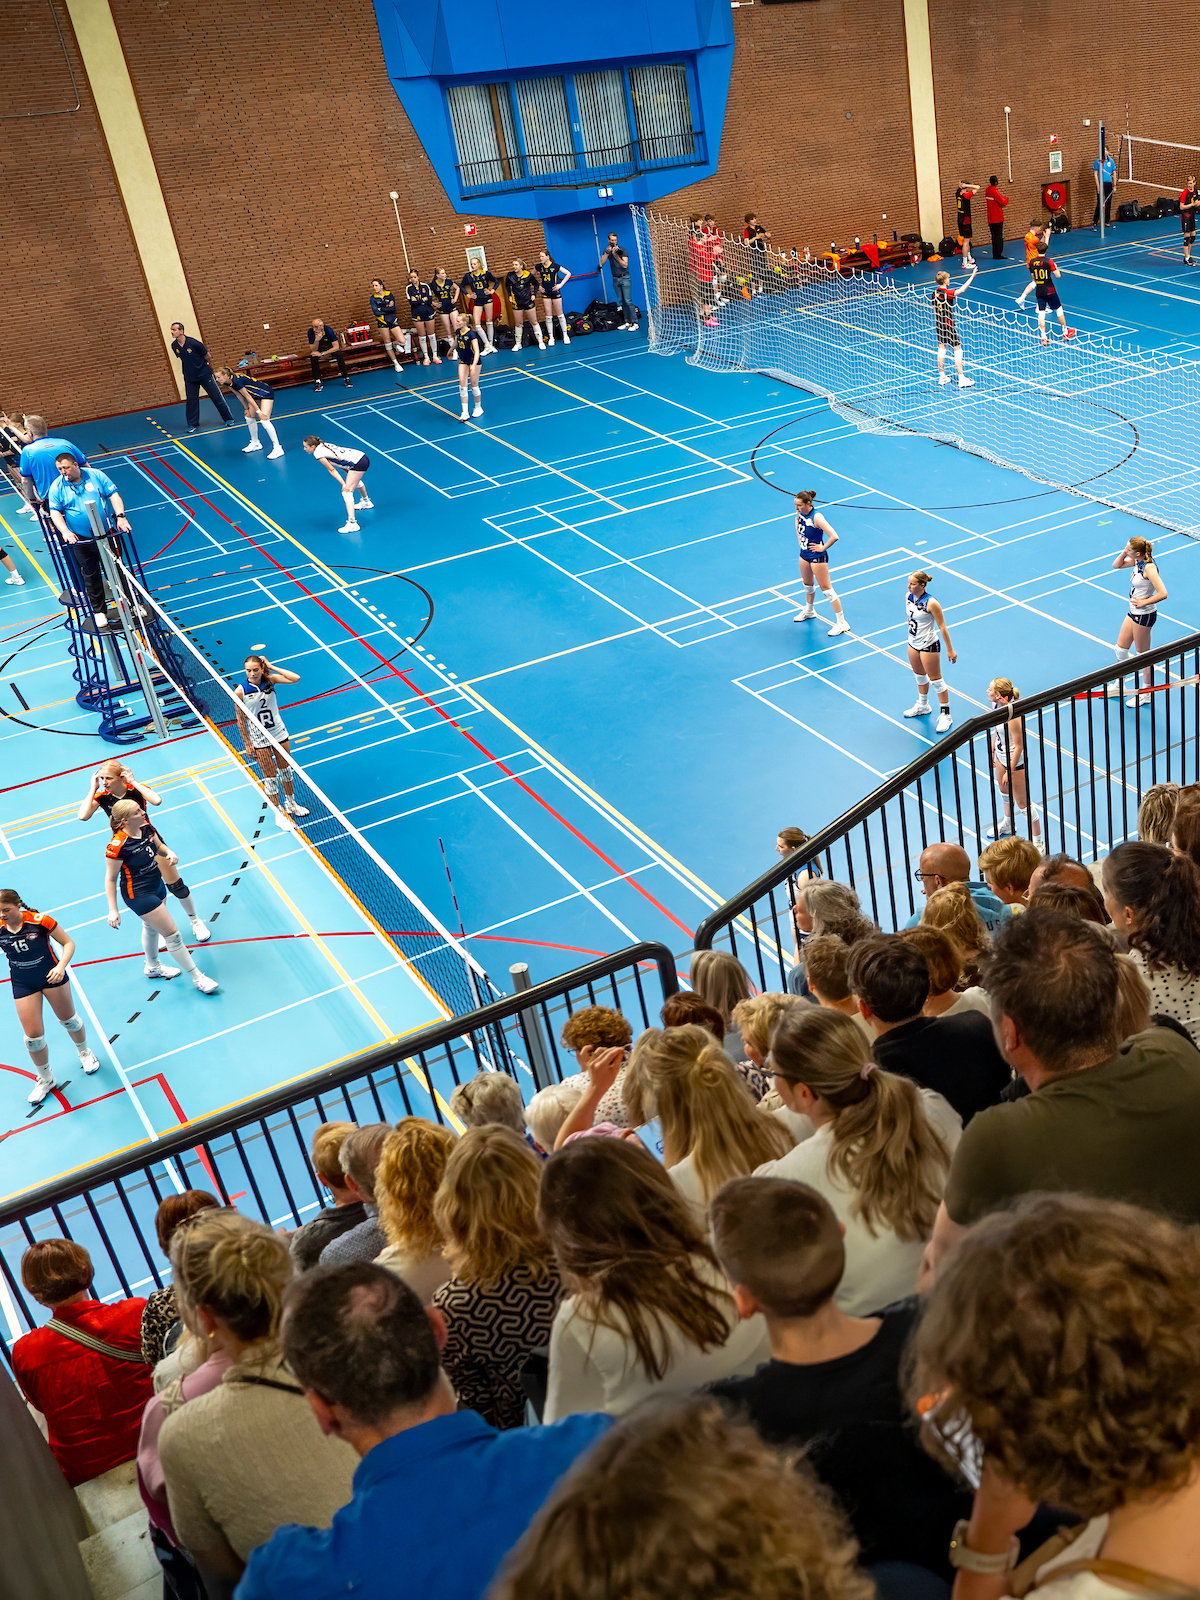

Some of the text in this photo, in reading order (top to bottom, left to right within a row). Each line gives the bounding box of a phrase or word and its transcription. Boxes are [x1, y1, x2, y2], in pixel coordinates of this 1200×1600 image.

[440, 291, 449, 299] 22
[259, 698, 267, 708] 2
[146, 846, 154, 857] 3
[11, 939, 29, 953] 15
